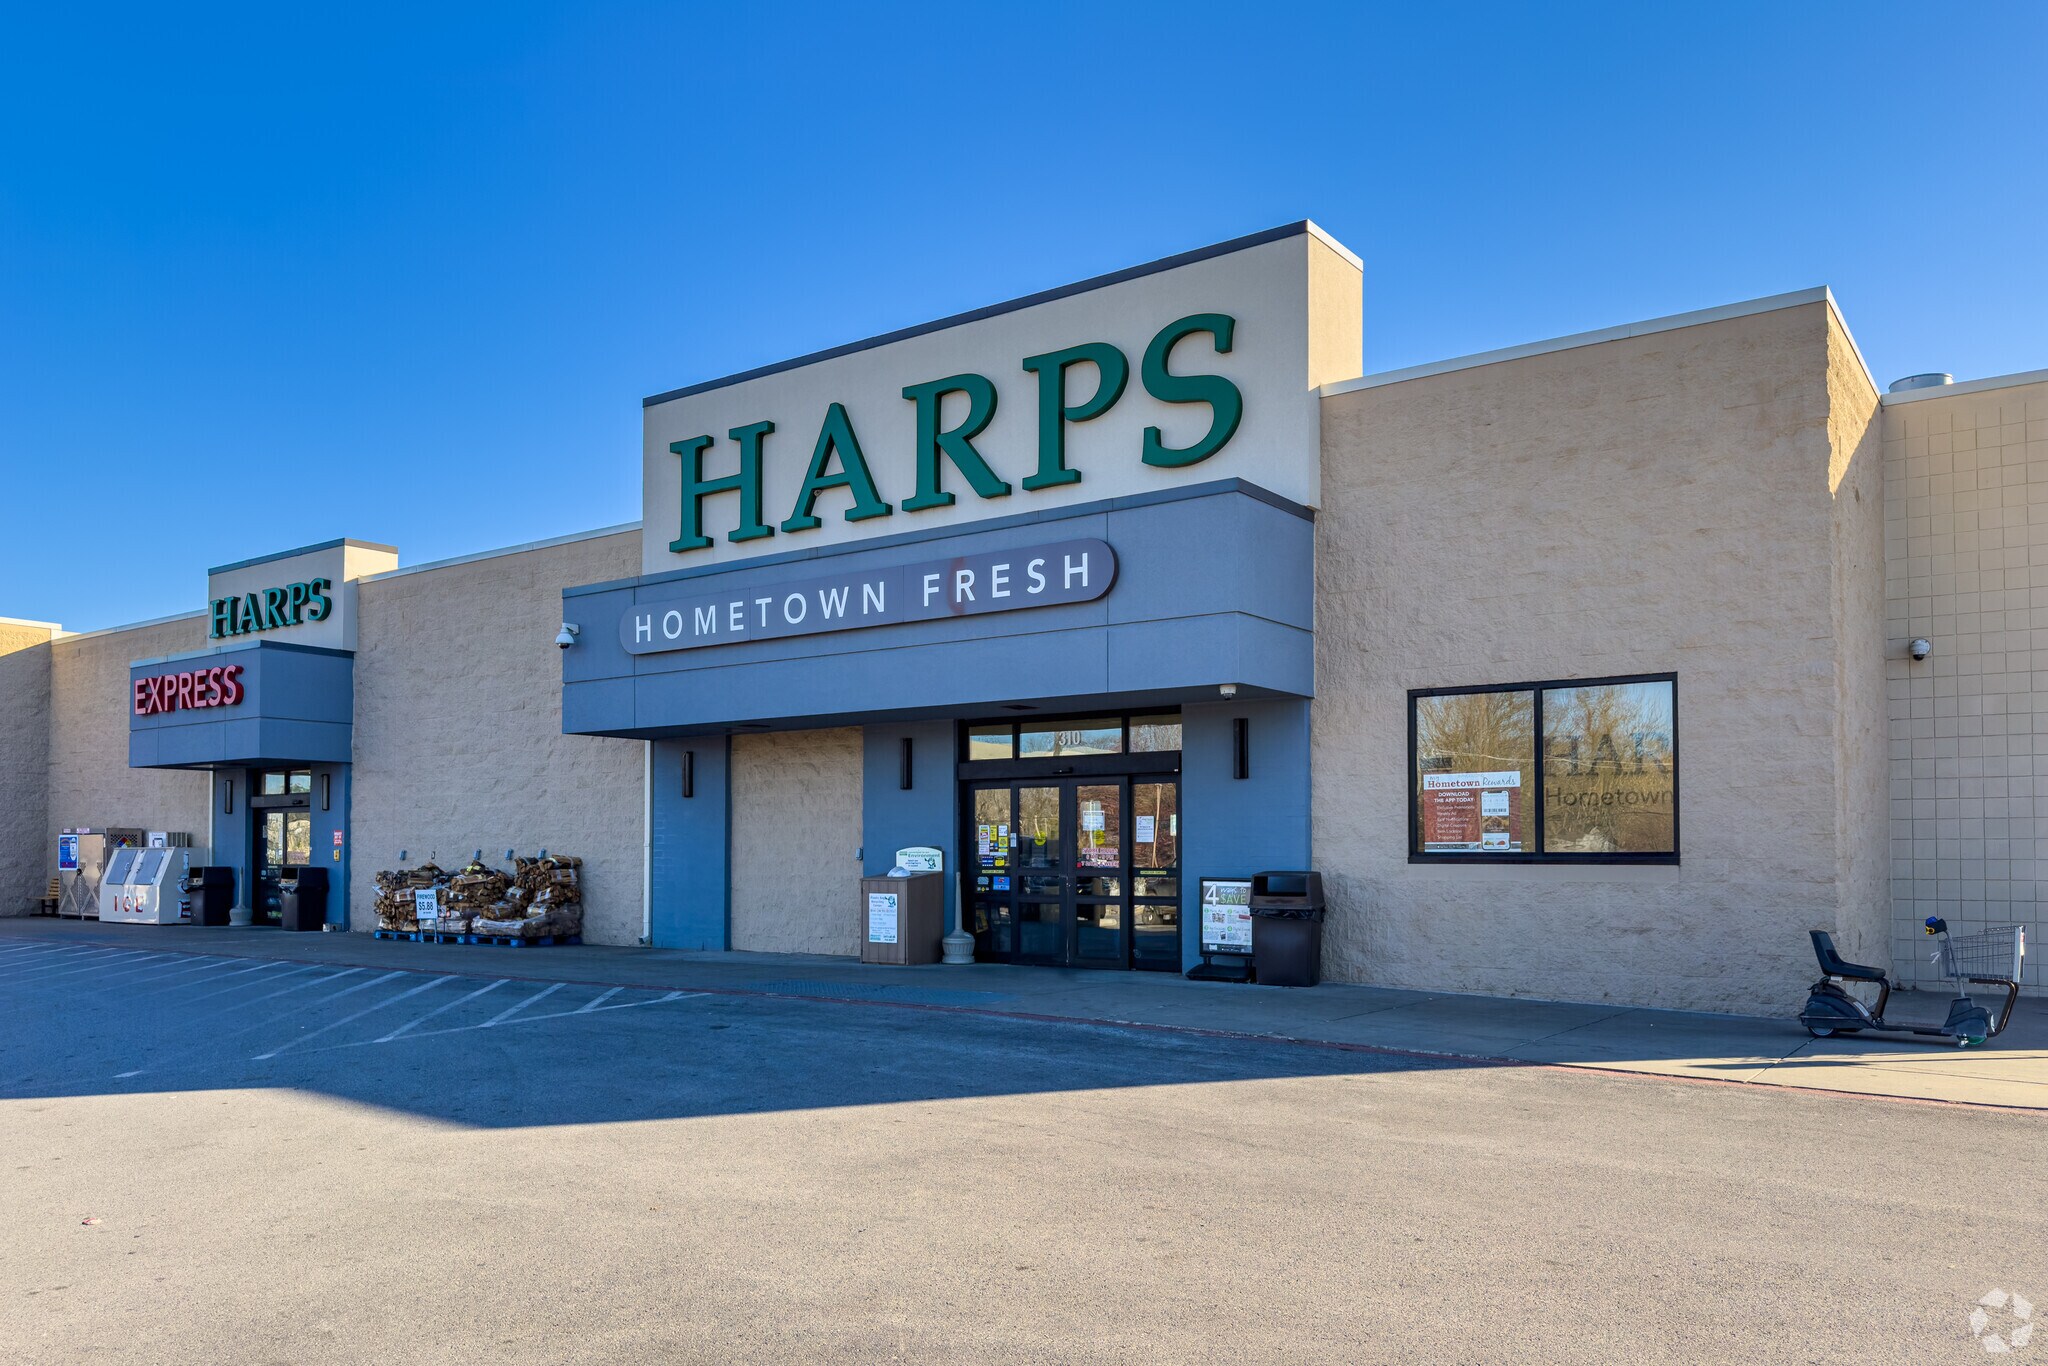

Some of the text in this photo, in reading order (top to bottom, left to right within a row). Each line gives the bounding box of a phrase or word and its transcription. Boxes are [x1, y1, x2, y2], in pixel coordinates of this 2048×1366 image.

[669, 313, 1242, 553] HARPS
[209, 577, 332, 640] HARPS
[634, 552, 1088, 643] HOMETOWN FRESH
[134, 664, 244, 716] EXPRESS
[1059, 730, 1082, 746] 310
[1428, 775, 1516, 788] Hometown Rewards
[1545, 787, 1673, 807] Hometown
[114, 895, 144, 913] ICE
[1205, 884, 1219, 907] 4
